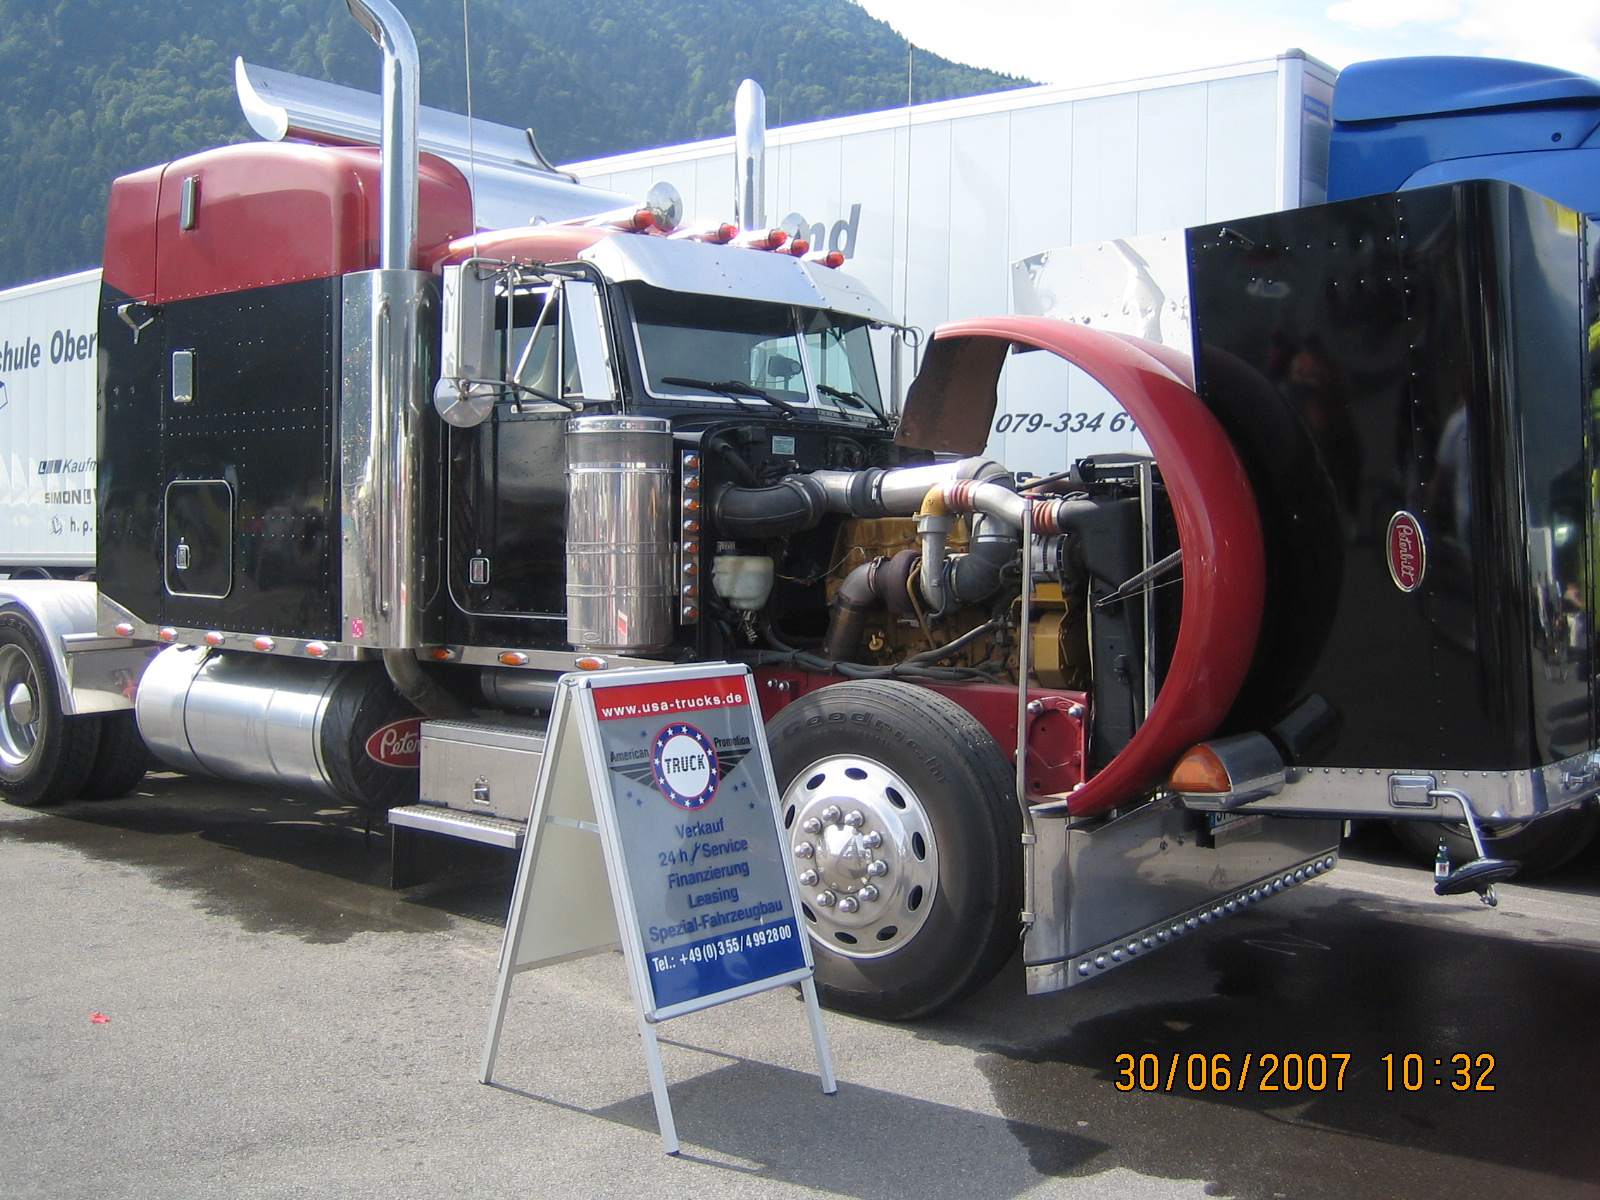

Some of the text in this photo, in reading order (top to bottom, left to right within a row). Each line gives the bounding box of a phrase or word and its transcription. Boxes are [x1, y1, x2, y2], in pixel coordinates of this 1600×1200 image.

[0, 328, 98, 372] hule Ober
[995, 412, 1105, 433] 079-334
[601, 692, 743, 718] www.usa-trucks.de
[713, 734, 751, 748] Promotion
[610, 747, 650, 763] American
[664, 753, 706, 775] TRUCK
[675, 816, 725, 839] Verkauf
[658, 851, 676, 867] 24
[701, 838, 749, 858] Service
[668, 861, 750, 889] Finanzierung
[687, 886, 739, 909] Leasing
[648, 899, 783, 944] Spezial-Fahrzeugbau
[651, 953, 677, 973] Tel.:
